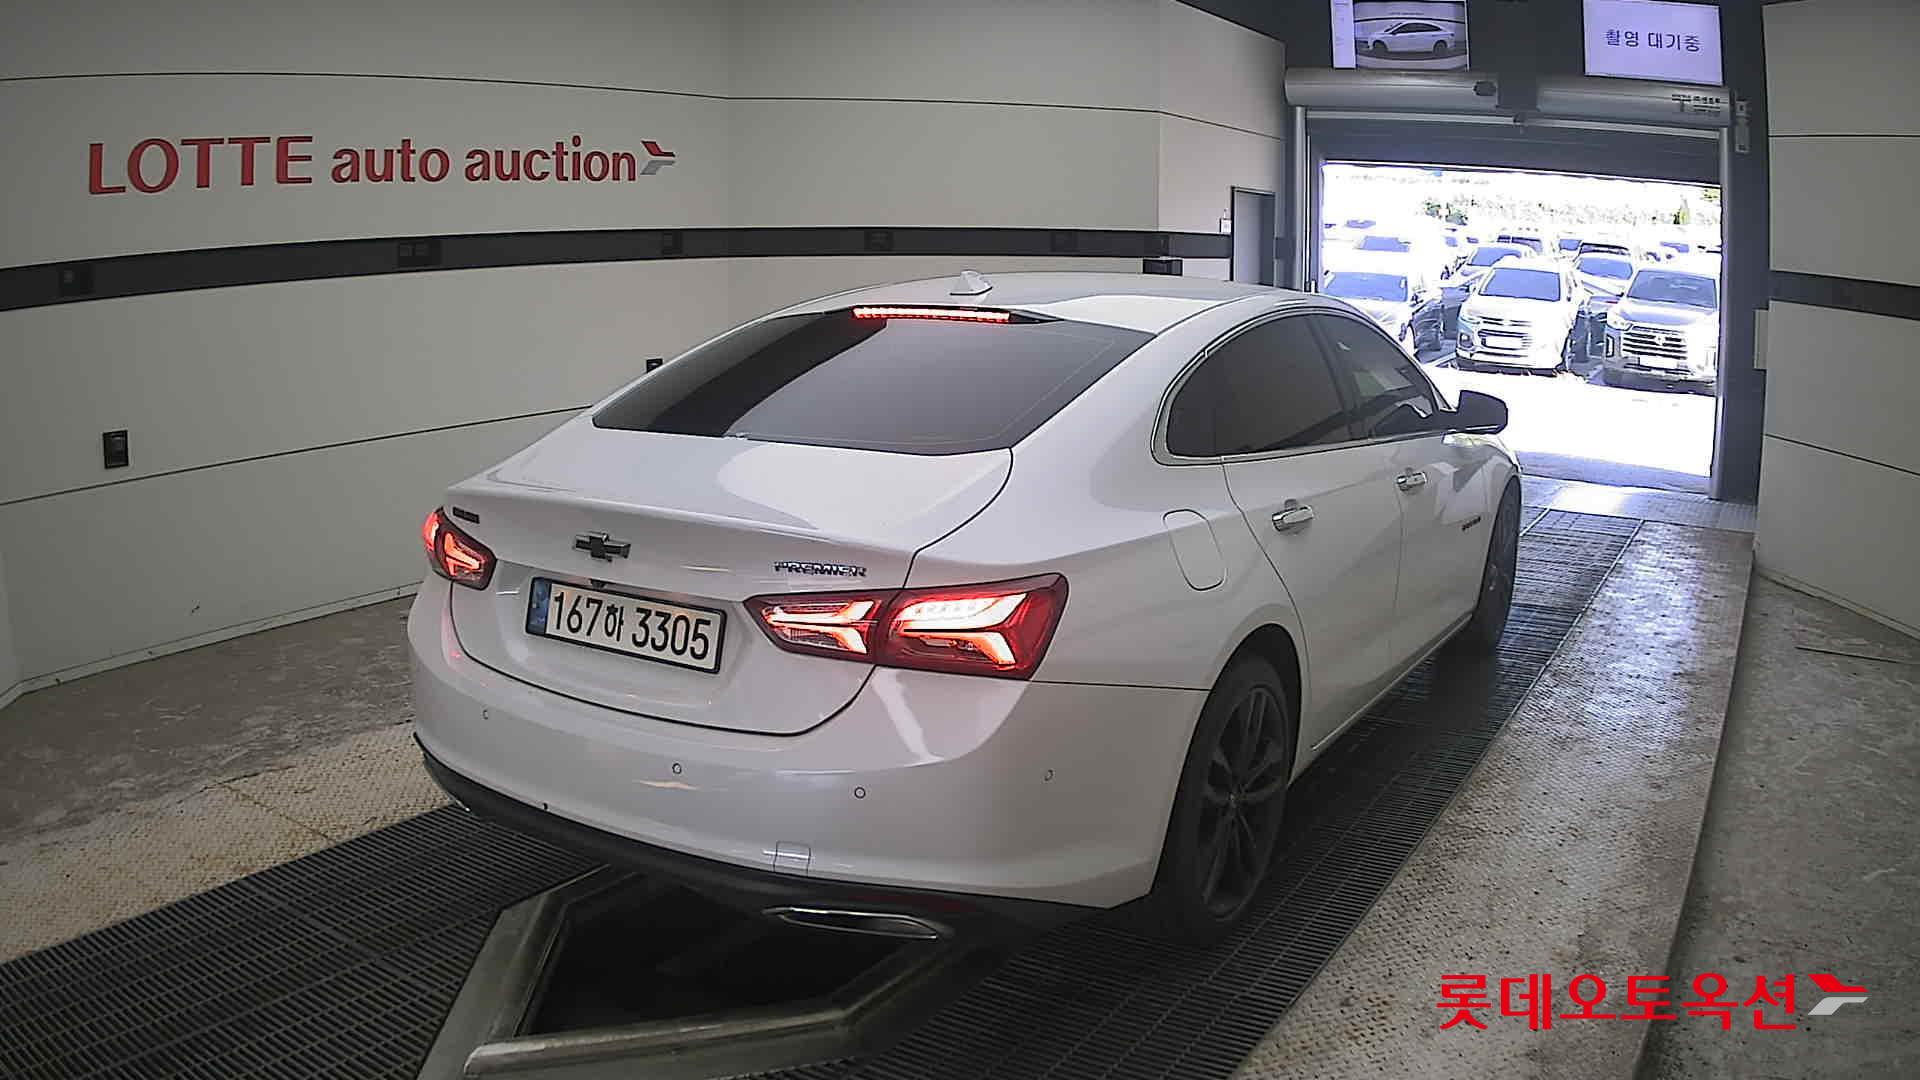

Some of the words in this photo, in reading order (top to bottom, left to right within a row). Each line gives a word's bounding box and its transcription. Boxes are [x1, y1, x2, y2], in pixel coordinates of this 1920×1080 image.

[1647, 31, 1701, 53] 대기중
[89, 136, 313, 195] LOTTE
[331, 138, 450, 183] auto
[464, 135, 636, 182] auction
[774, 561, 867, 577] PREMIER
[553, 591, 625, 642] 167하
[631, 607, 712, 660] 3305
